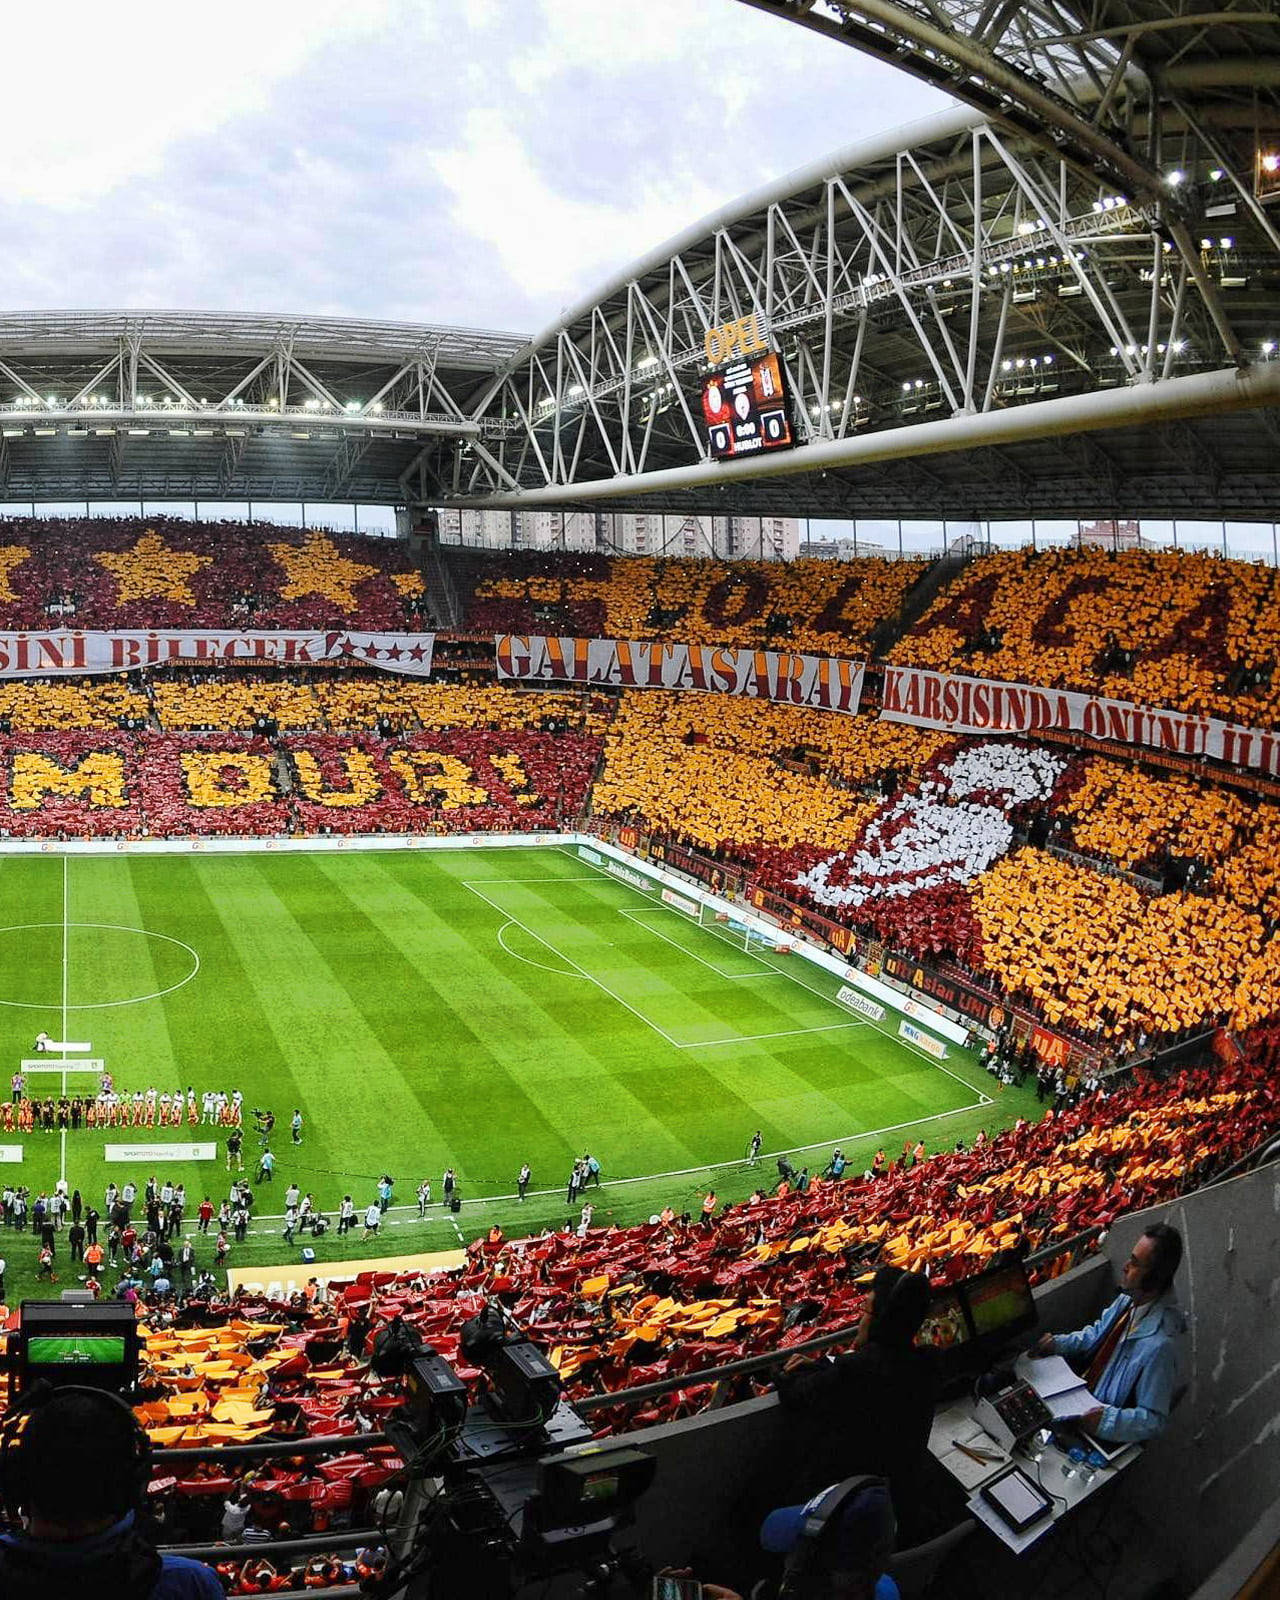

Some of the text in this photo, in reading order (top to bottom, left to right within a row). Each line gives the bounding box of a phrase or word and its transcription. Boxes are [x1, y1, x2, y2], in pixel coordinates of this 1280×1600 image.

[705, 314, 768, 364] OPEL
[715, 431, 726, 449] 0
[770, 419, 780, 438] 0
[497, 634, 863, 712] GALATASARAY
[839, 988, 880, 1018] odeabank
